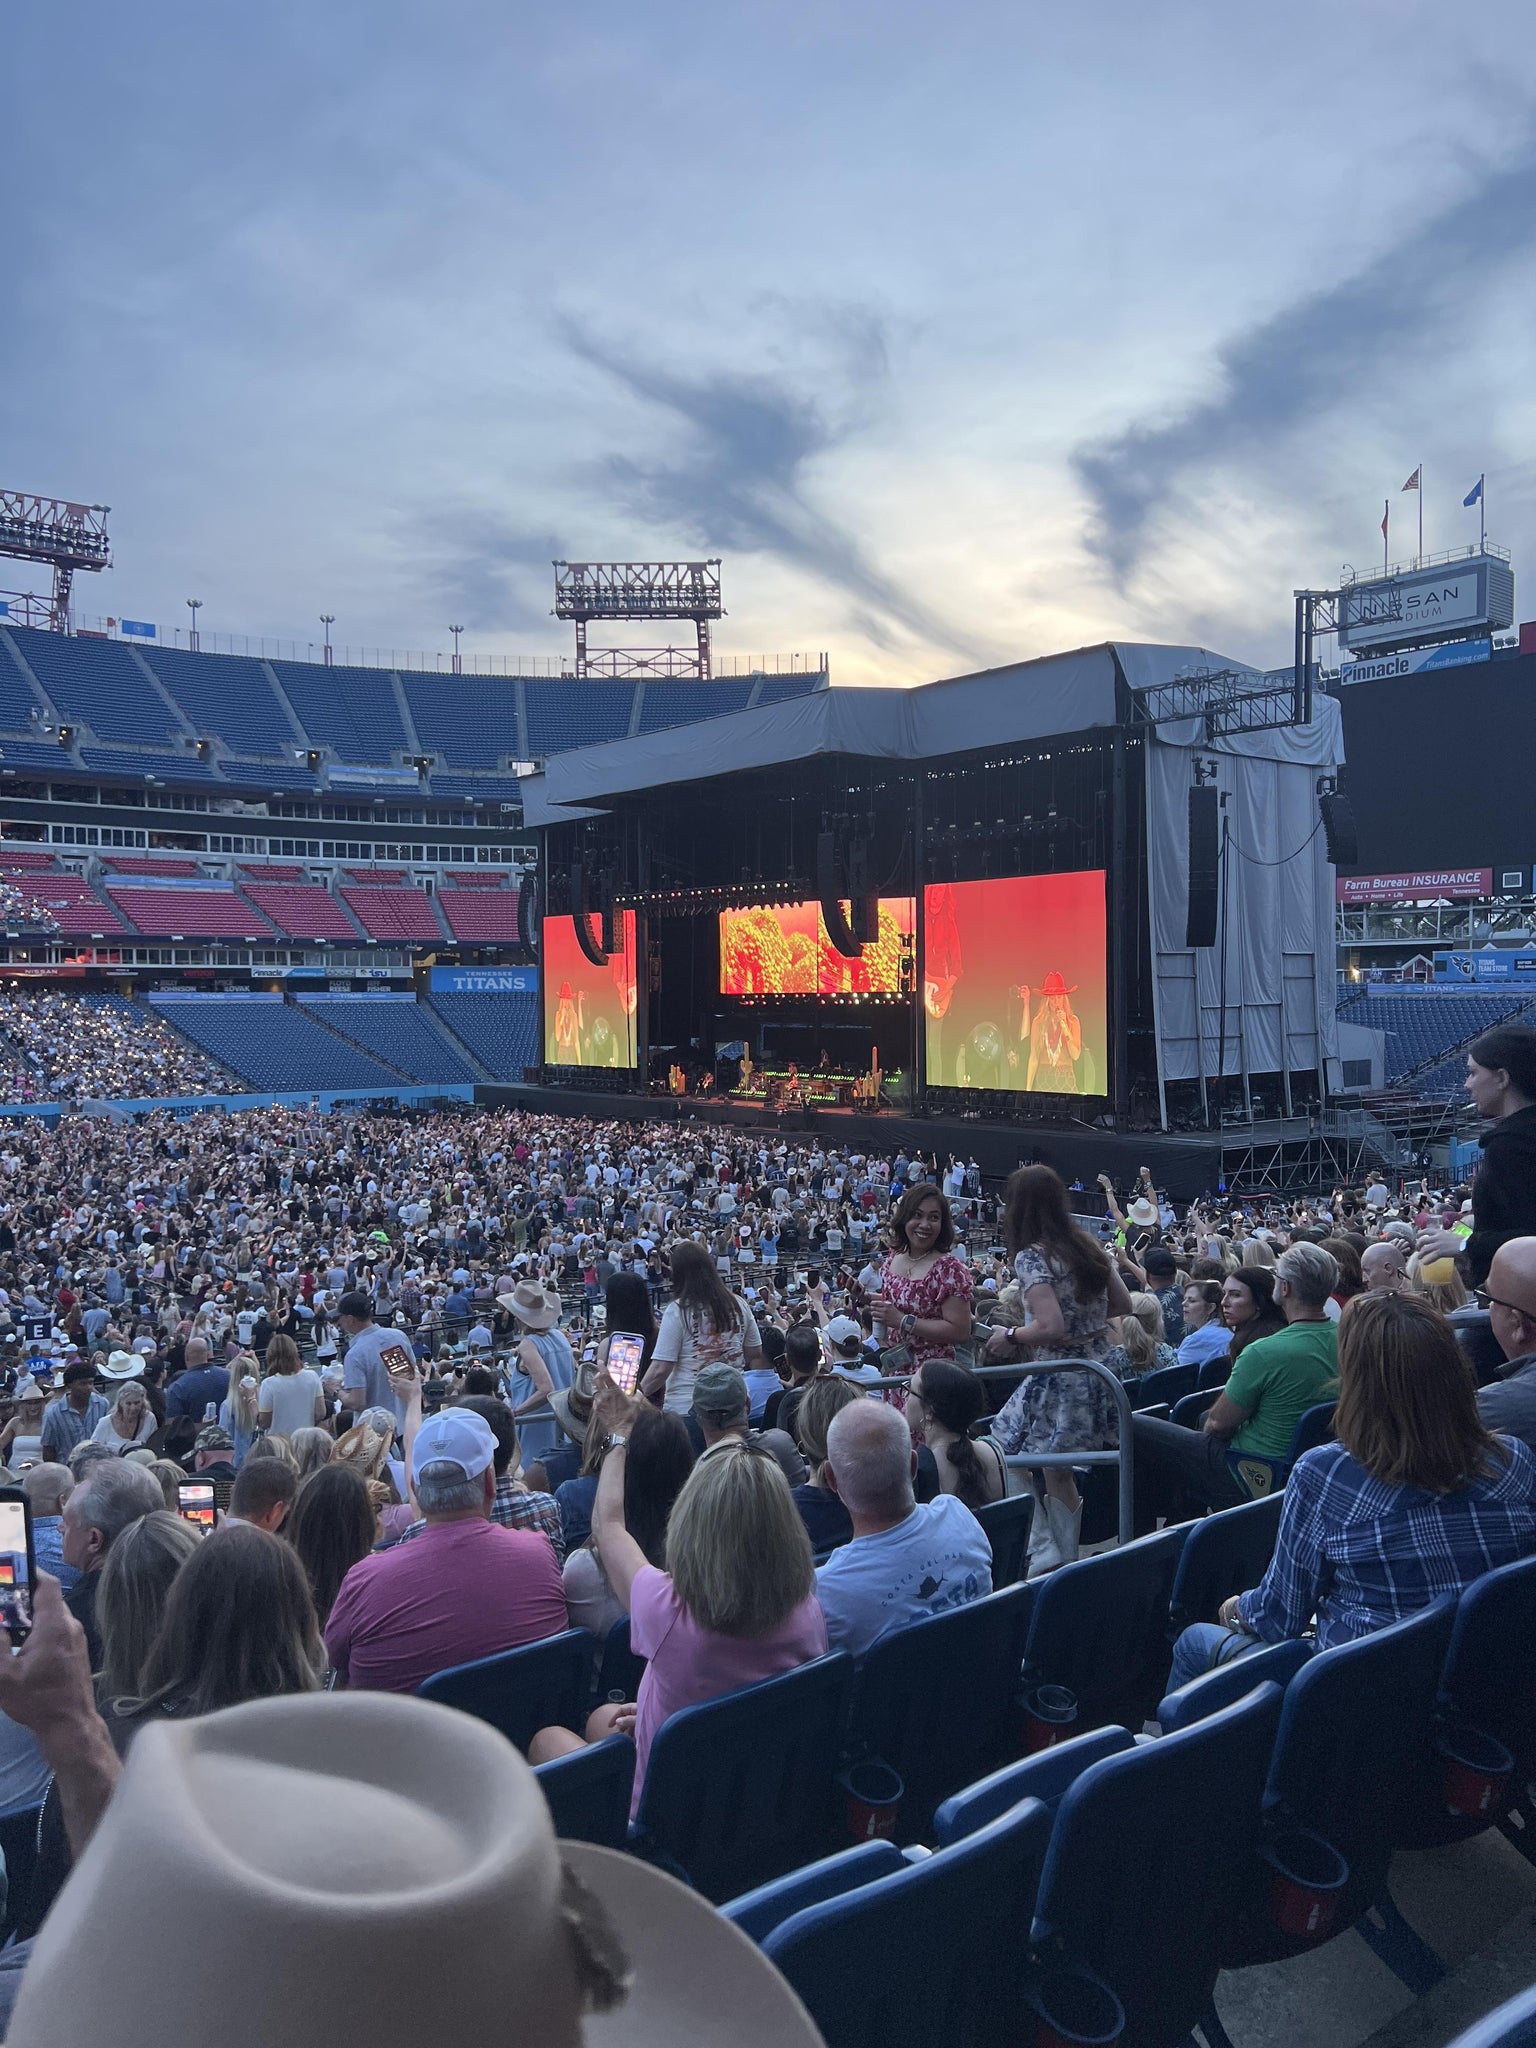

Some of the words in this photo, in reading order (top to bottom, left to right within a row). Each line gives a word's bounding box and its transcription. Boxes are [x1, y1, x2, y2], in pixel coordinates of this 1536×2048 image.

[1363, 587, 1459, 618] NISSAN
[1343, 657, 1409, 683] Pinnacle
[1345, 880, 1370, 890] Farm
[1373, 878, 1409, 889] Bureau
[1412, 872, 1481, 886] INSURANCE
[453, 977, 526, 990] TITANS
[34, 1325, 43, 1337] E
[881, 1573, 914, 1607] COSTA
[920, 1559, 939, 1571] DEL
